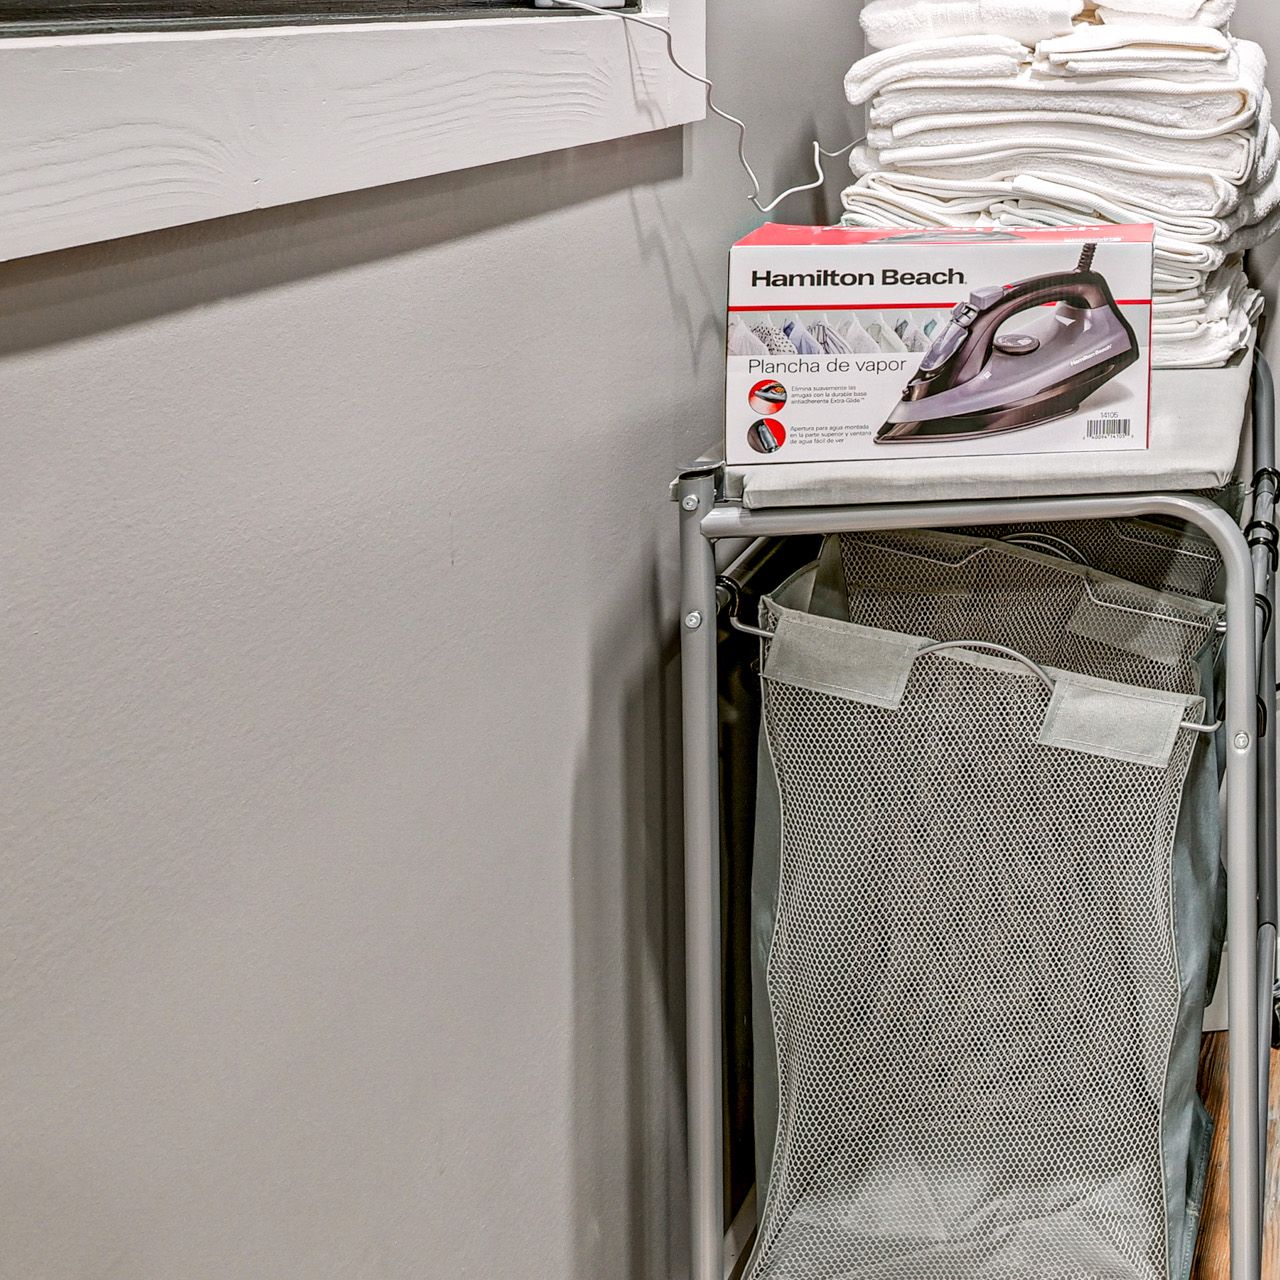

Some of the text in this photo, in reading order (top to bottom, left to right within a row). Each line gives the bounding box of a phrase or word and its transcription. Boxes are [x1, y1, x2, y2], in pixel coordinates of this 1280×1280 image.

[751, 268, 965, 287] Hamilton Beach
[748, 358, 906, 375] Plancha de vapor
[1070, 352, 1096, 367] Hamilton
